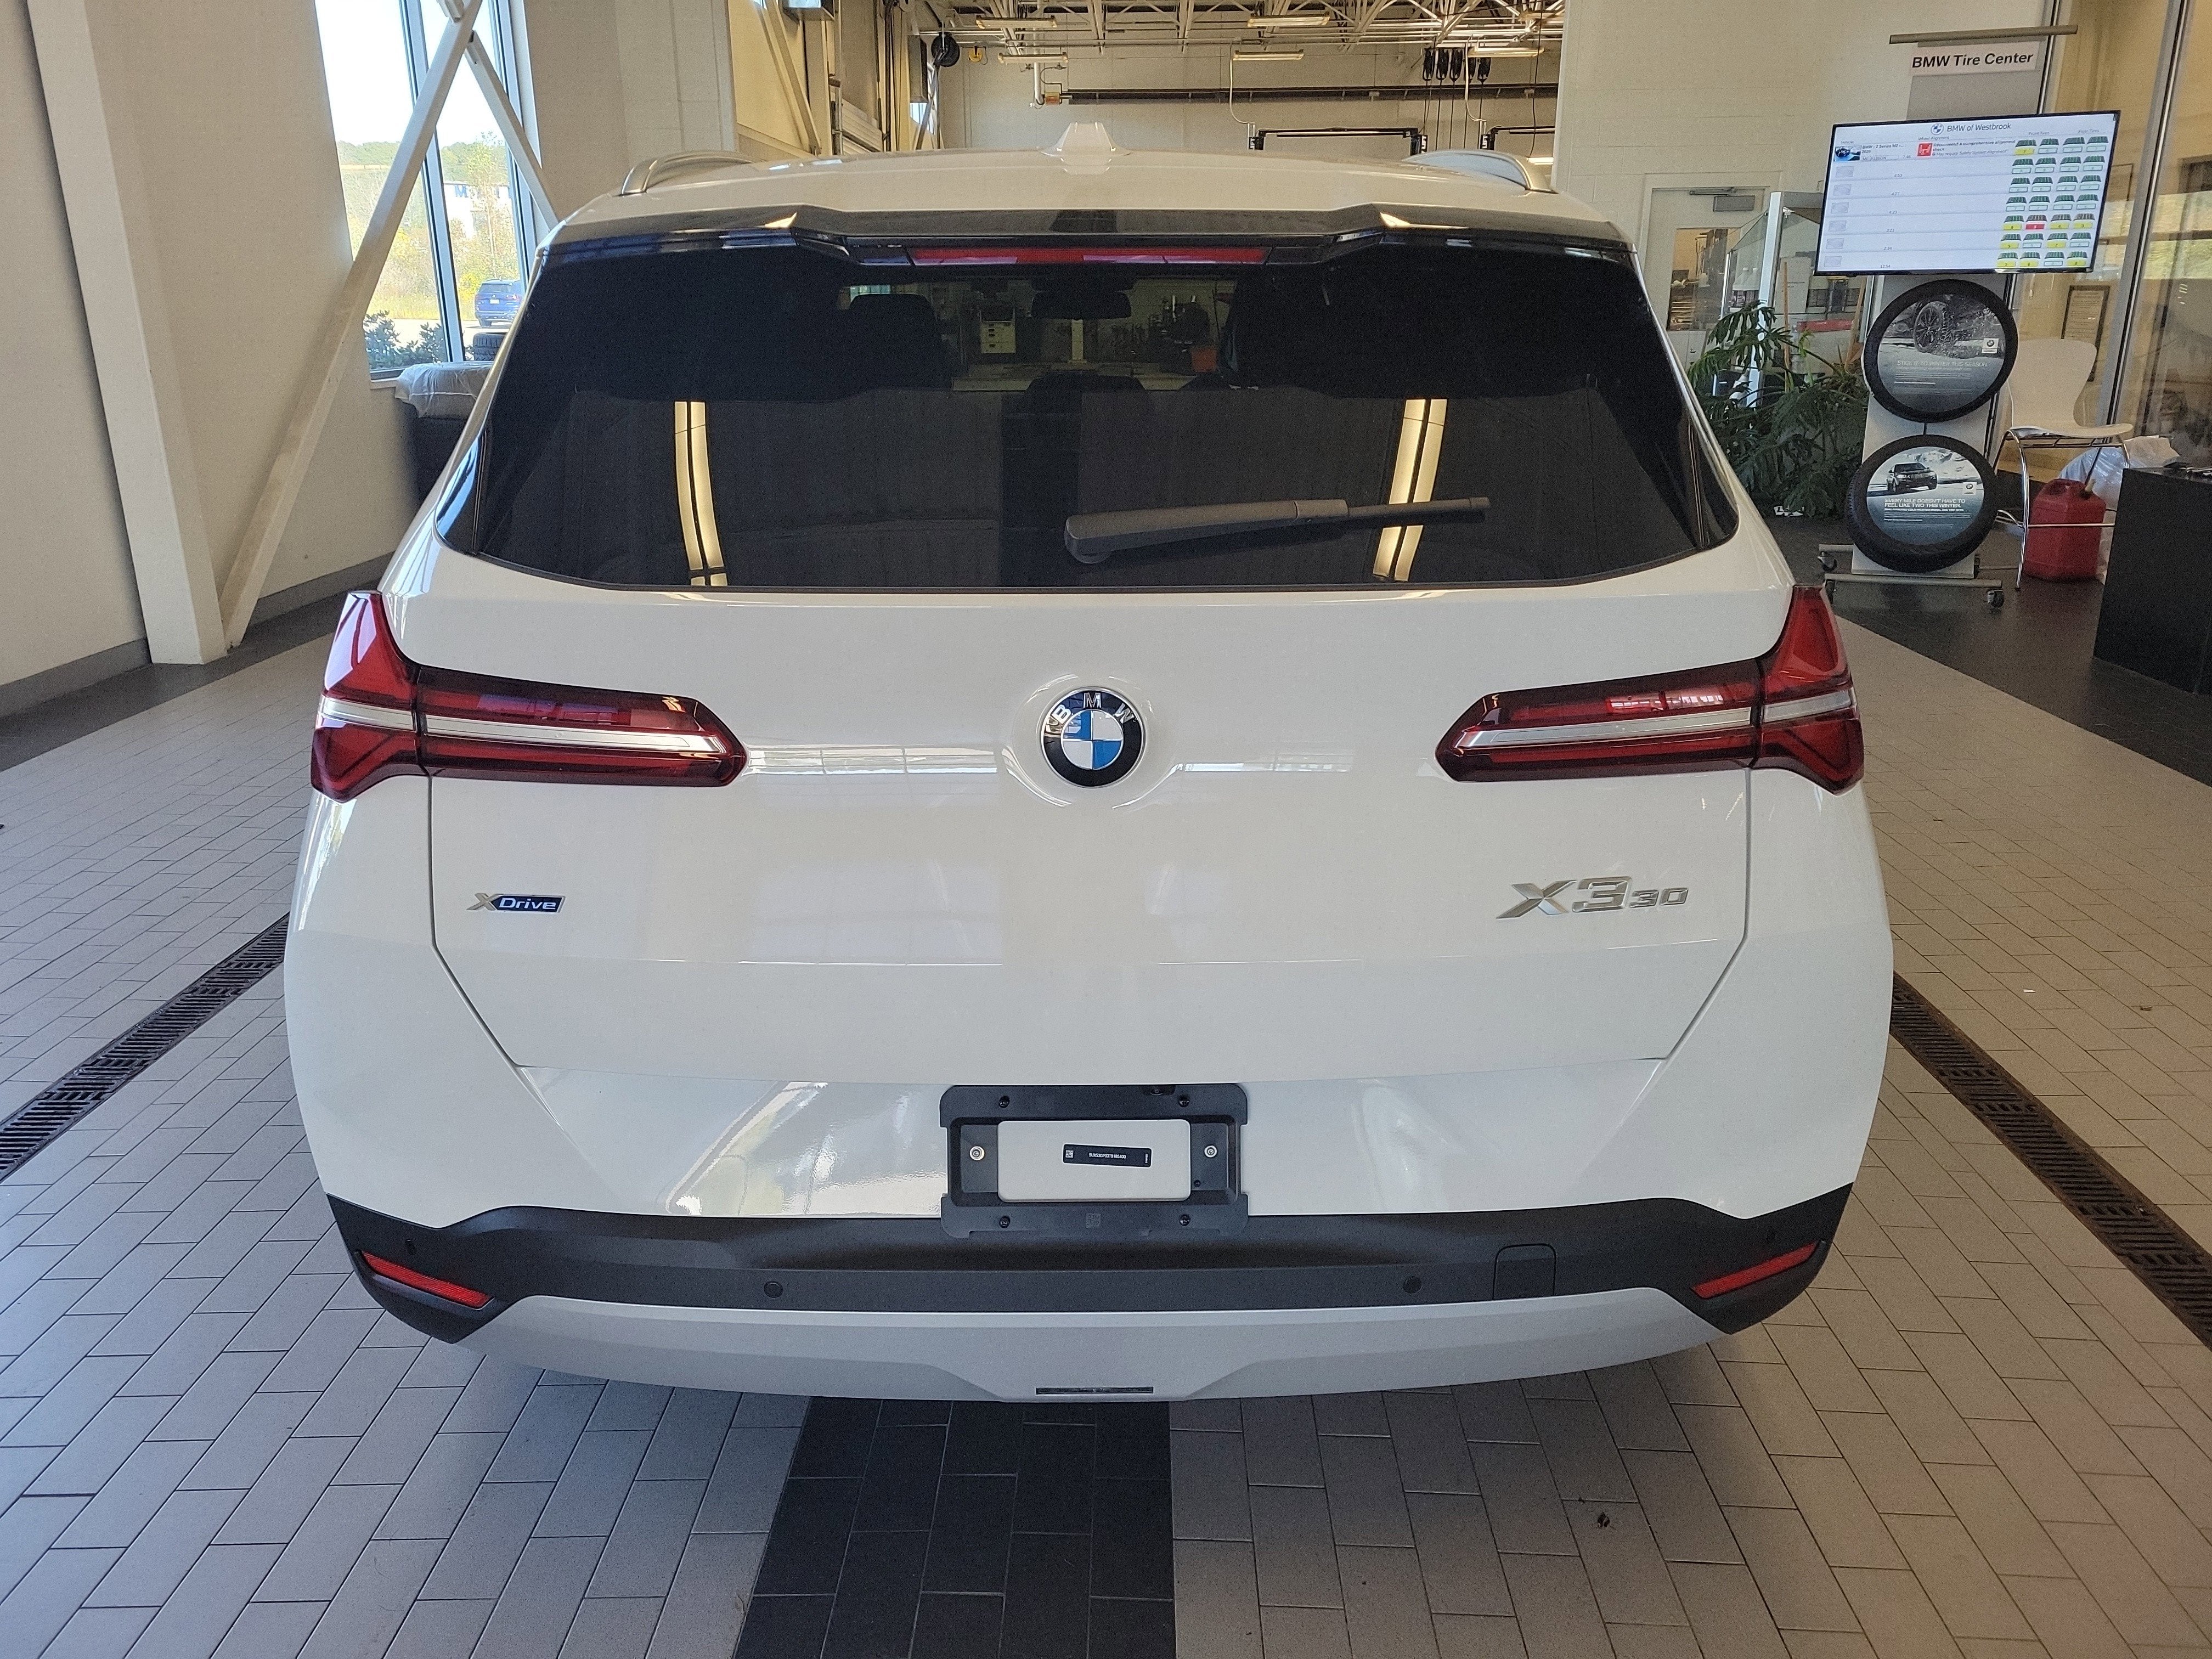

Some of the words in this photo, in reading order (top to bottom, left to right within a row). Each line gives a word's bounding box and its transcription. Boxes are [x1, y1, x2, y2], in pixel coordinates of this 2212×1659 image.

[1912, 55, 1951, 68] BMW
[1953, 54, 1980, 66] Tire
[1984, 53, 2034, 65] Center
[1975, 123, 2012, 131] Westbrook
[1496, 876, 1632, 919] X3
[1629, 887, 1689, 909] 30
